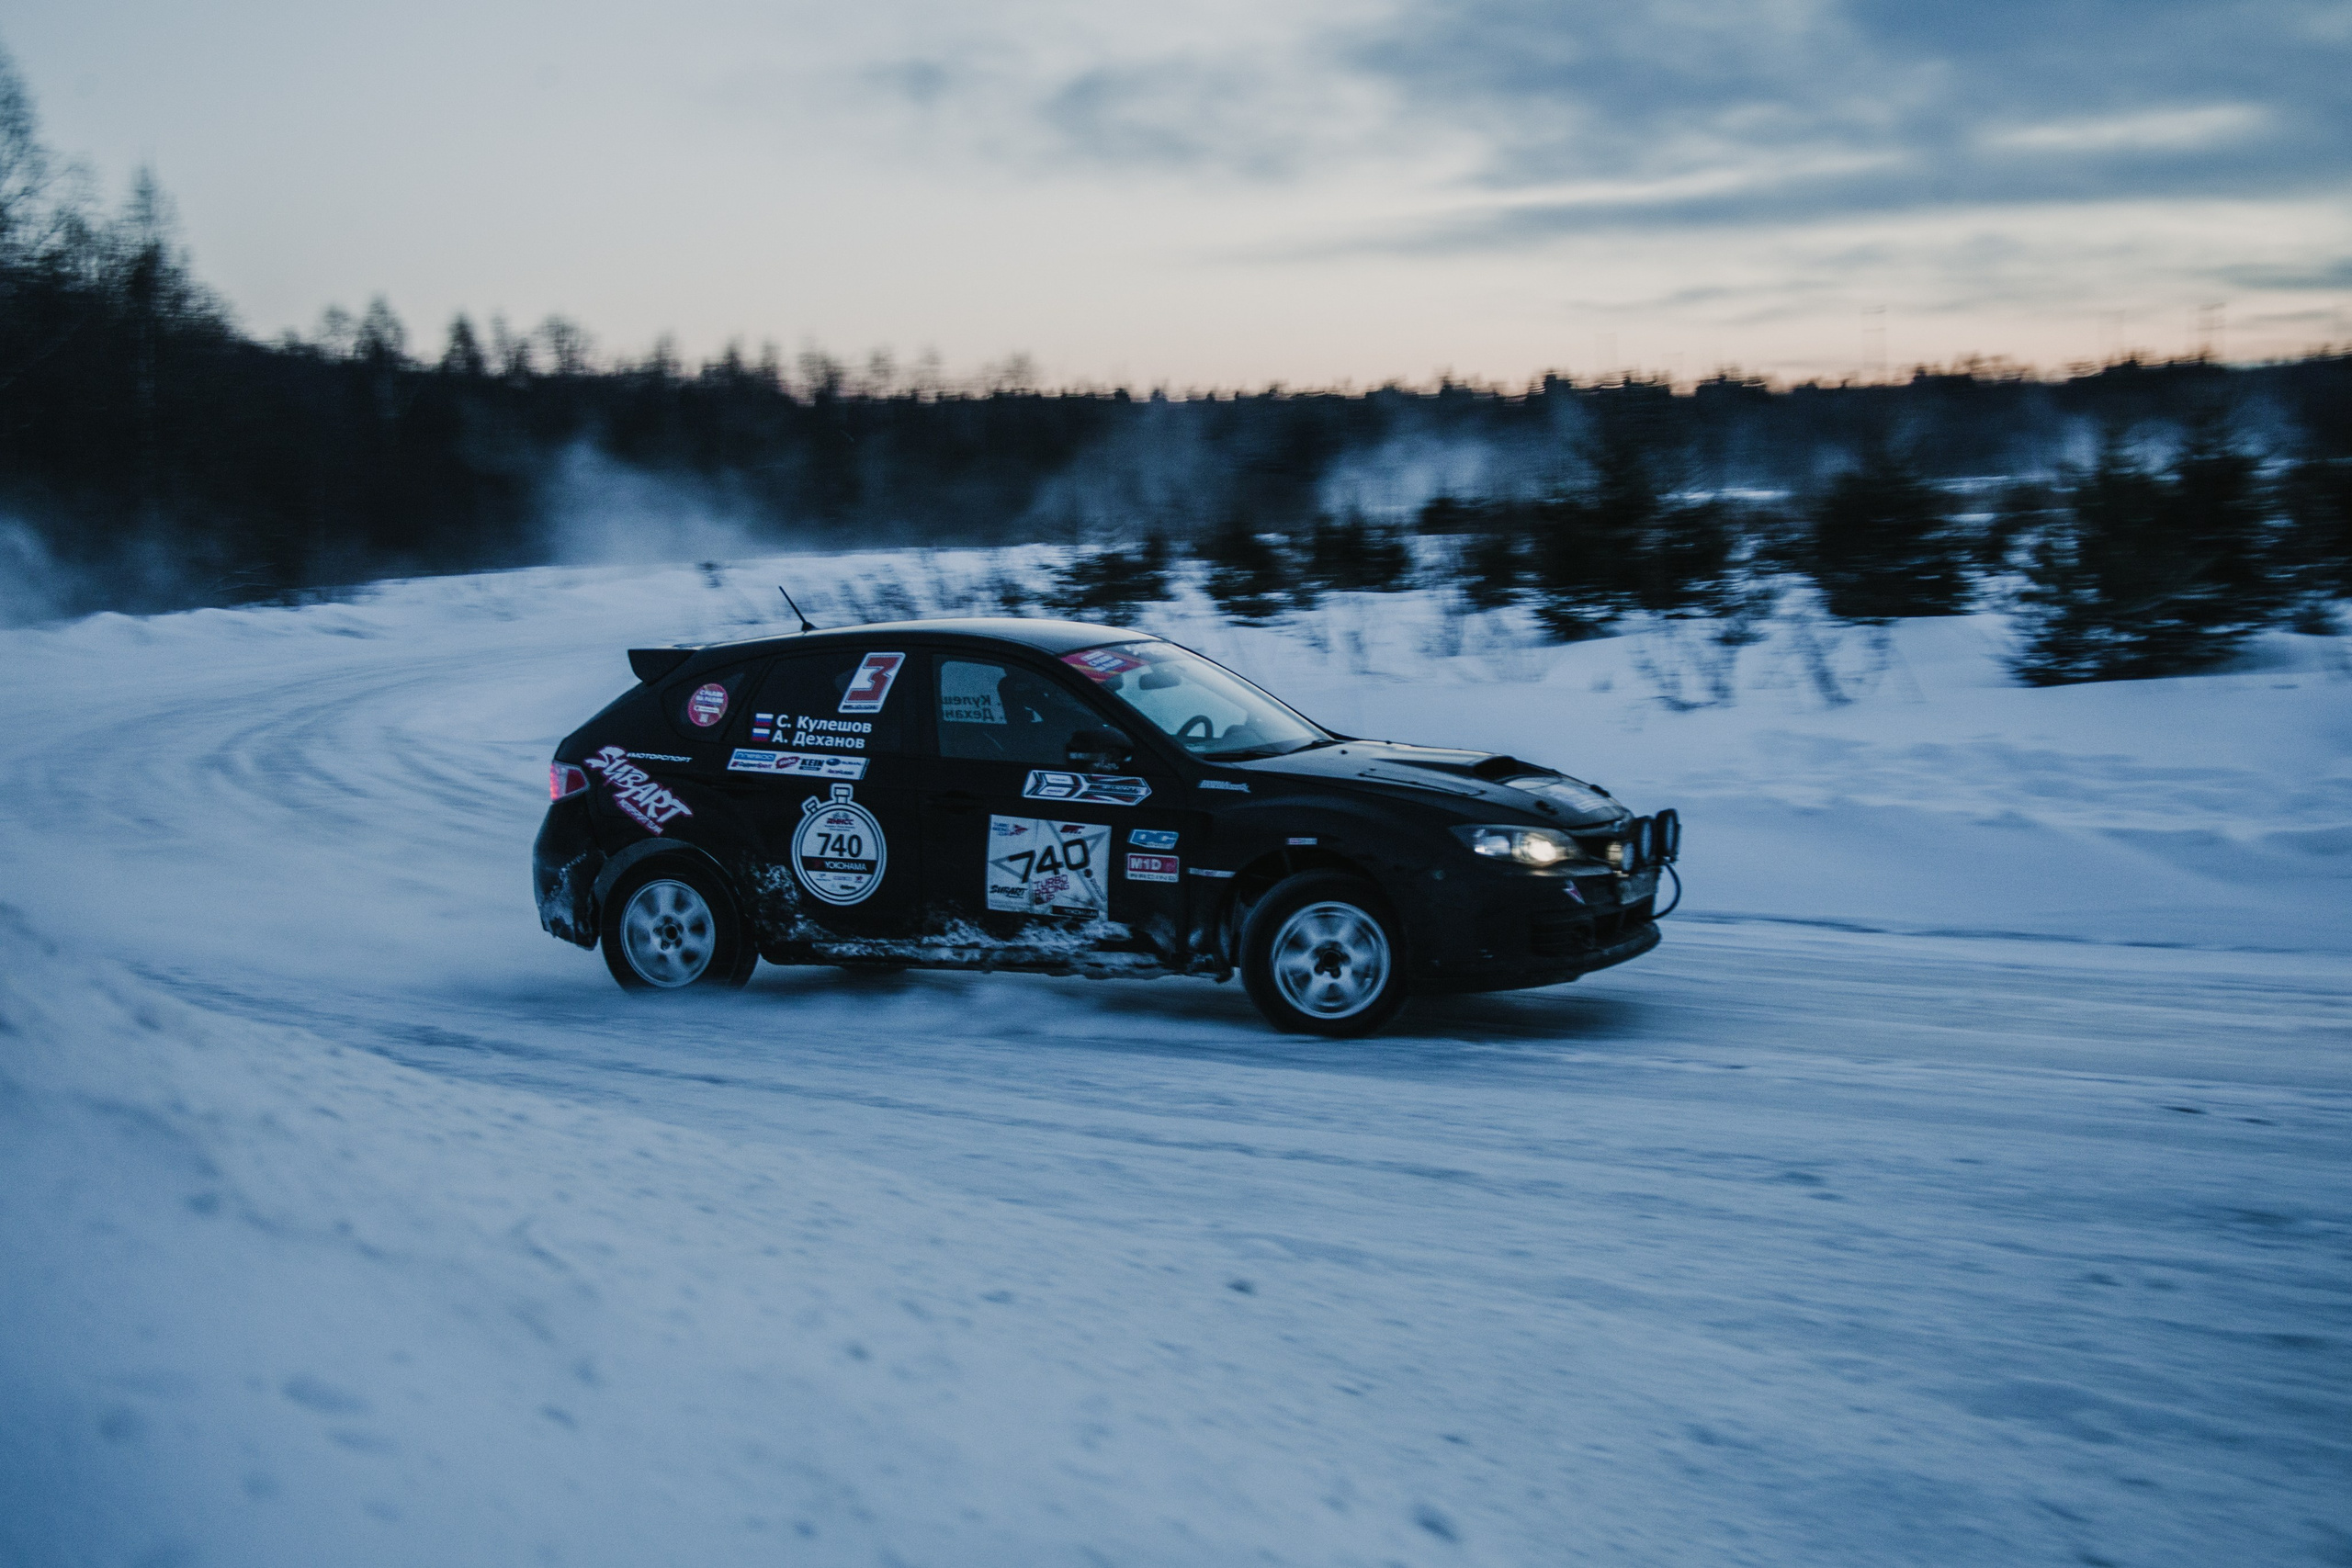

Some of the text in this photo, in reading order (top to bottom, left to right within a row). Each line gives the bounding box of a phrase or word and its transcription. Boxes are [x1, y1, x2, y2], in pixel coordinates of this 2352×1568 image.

[843, 654, 902, 704] 3
[776, 714, 872, 734] С. Кулешов
[772, 729, 865, 750] А. Деханов
[817, 832, 863, 859] 740
[824, 861, 867, 872] YOKOHAMA
[1008, 838, 1091, 885] 740
[1035, 894, 1056, 906] UP
